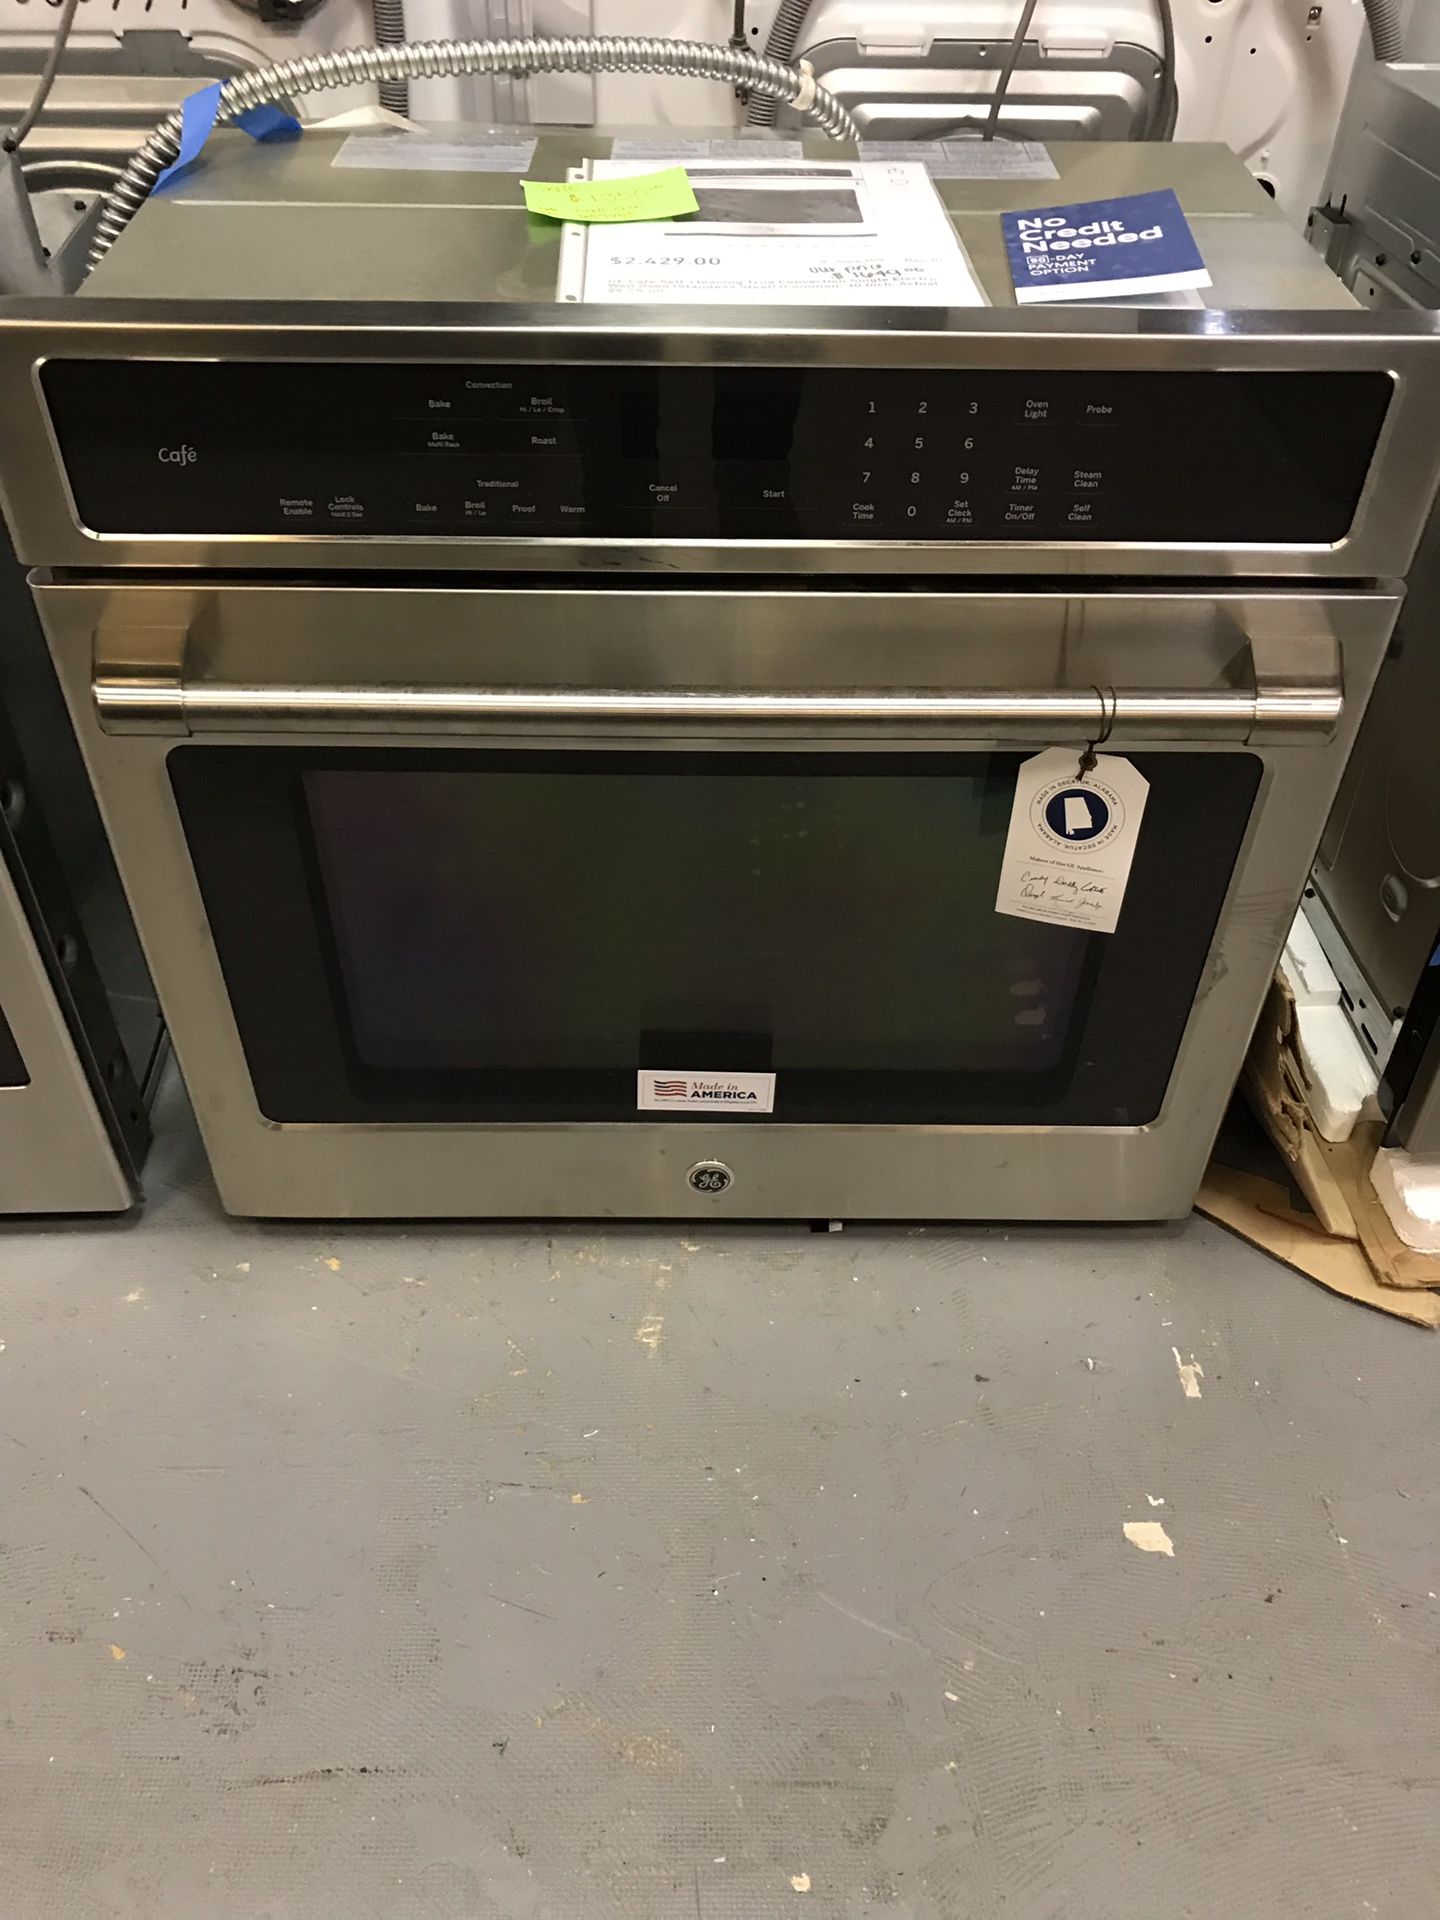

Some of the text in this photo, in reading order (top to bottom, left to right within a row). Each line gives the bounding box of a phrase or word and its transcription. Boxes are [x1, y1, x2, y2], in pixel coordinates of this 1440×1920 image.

[1017, 217, 1067, 230] No
[1019, 220, 1125, 241] Credit
[1023, 226, 1163, 253] Needed
[1028, 259, 1096, 270] PAYMENT
[1030, 265, 1089, 275] OPTION
[429, 400, 450, 408] Bake
[531, 397, 552, 405] Broil
[1026, 400, 1048, 408] Oven
[869, 402, 977, 414] 1 2 3
[1087, 405, 1112, 413] Probe
[1025, 410, 1047, 419] Light
[432, 432, 454, 440] Bake
[864, 437, 973, 449] 4 5 6
[159, 445, 196, 466] Café
[1015, 467, 1039, 476] Delay
[863, 472, 969, 483] 7 8 9
[1016, 476, 1036, 484] Time
[649, 484, 677, 492] Cancel
[1074, 480, 1098, 488] Clean
[280, 499, 313, 507] Remote
[328, 503, 364, 511] Controls
[465, 501, 485, 509] Broil
[853, 503, 874, 511] Cook
[954, 500, 968, 508] Set
[907, 506, 916, 516] 0
[1009, 504, 1034, 512] Timer
[1073, 504, 1090, 512] Self
[853, 512, 874, 520] Time
[948, 509, 971, 517] Clock
[1005, 512, 1035, 520] On/Off
[1036, 790, 1049, 805] MADE
[1094, 783, 1118, 805] ALABAMA
[691, 1082, 738, 1090] Made in
[691, 1091, 757, 1099] AMERICA
